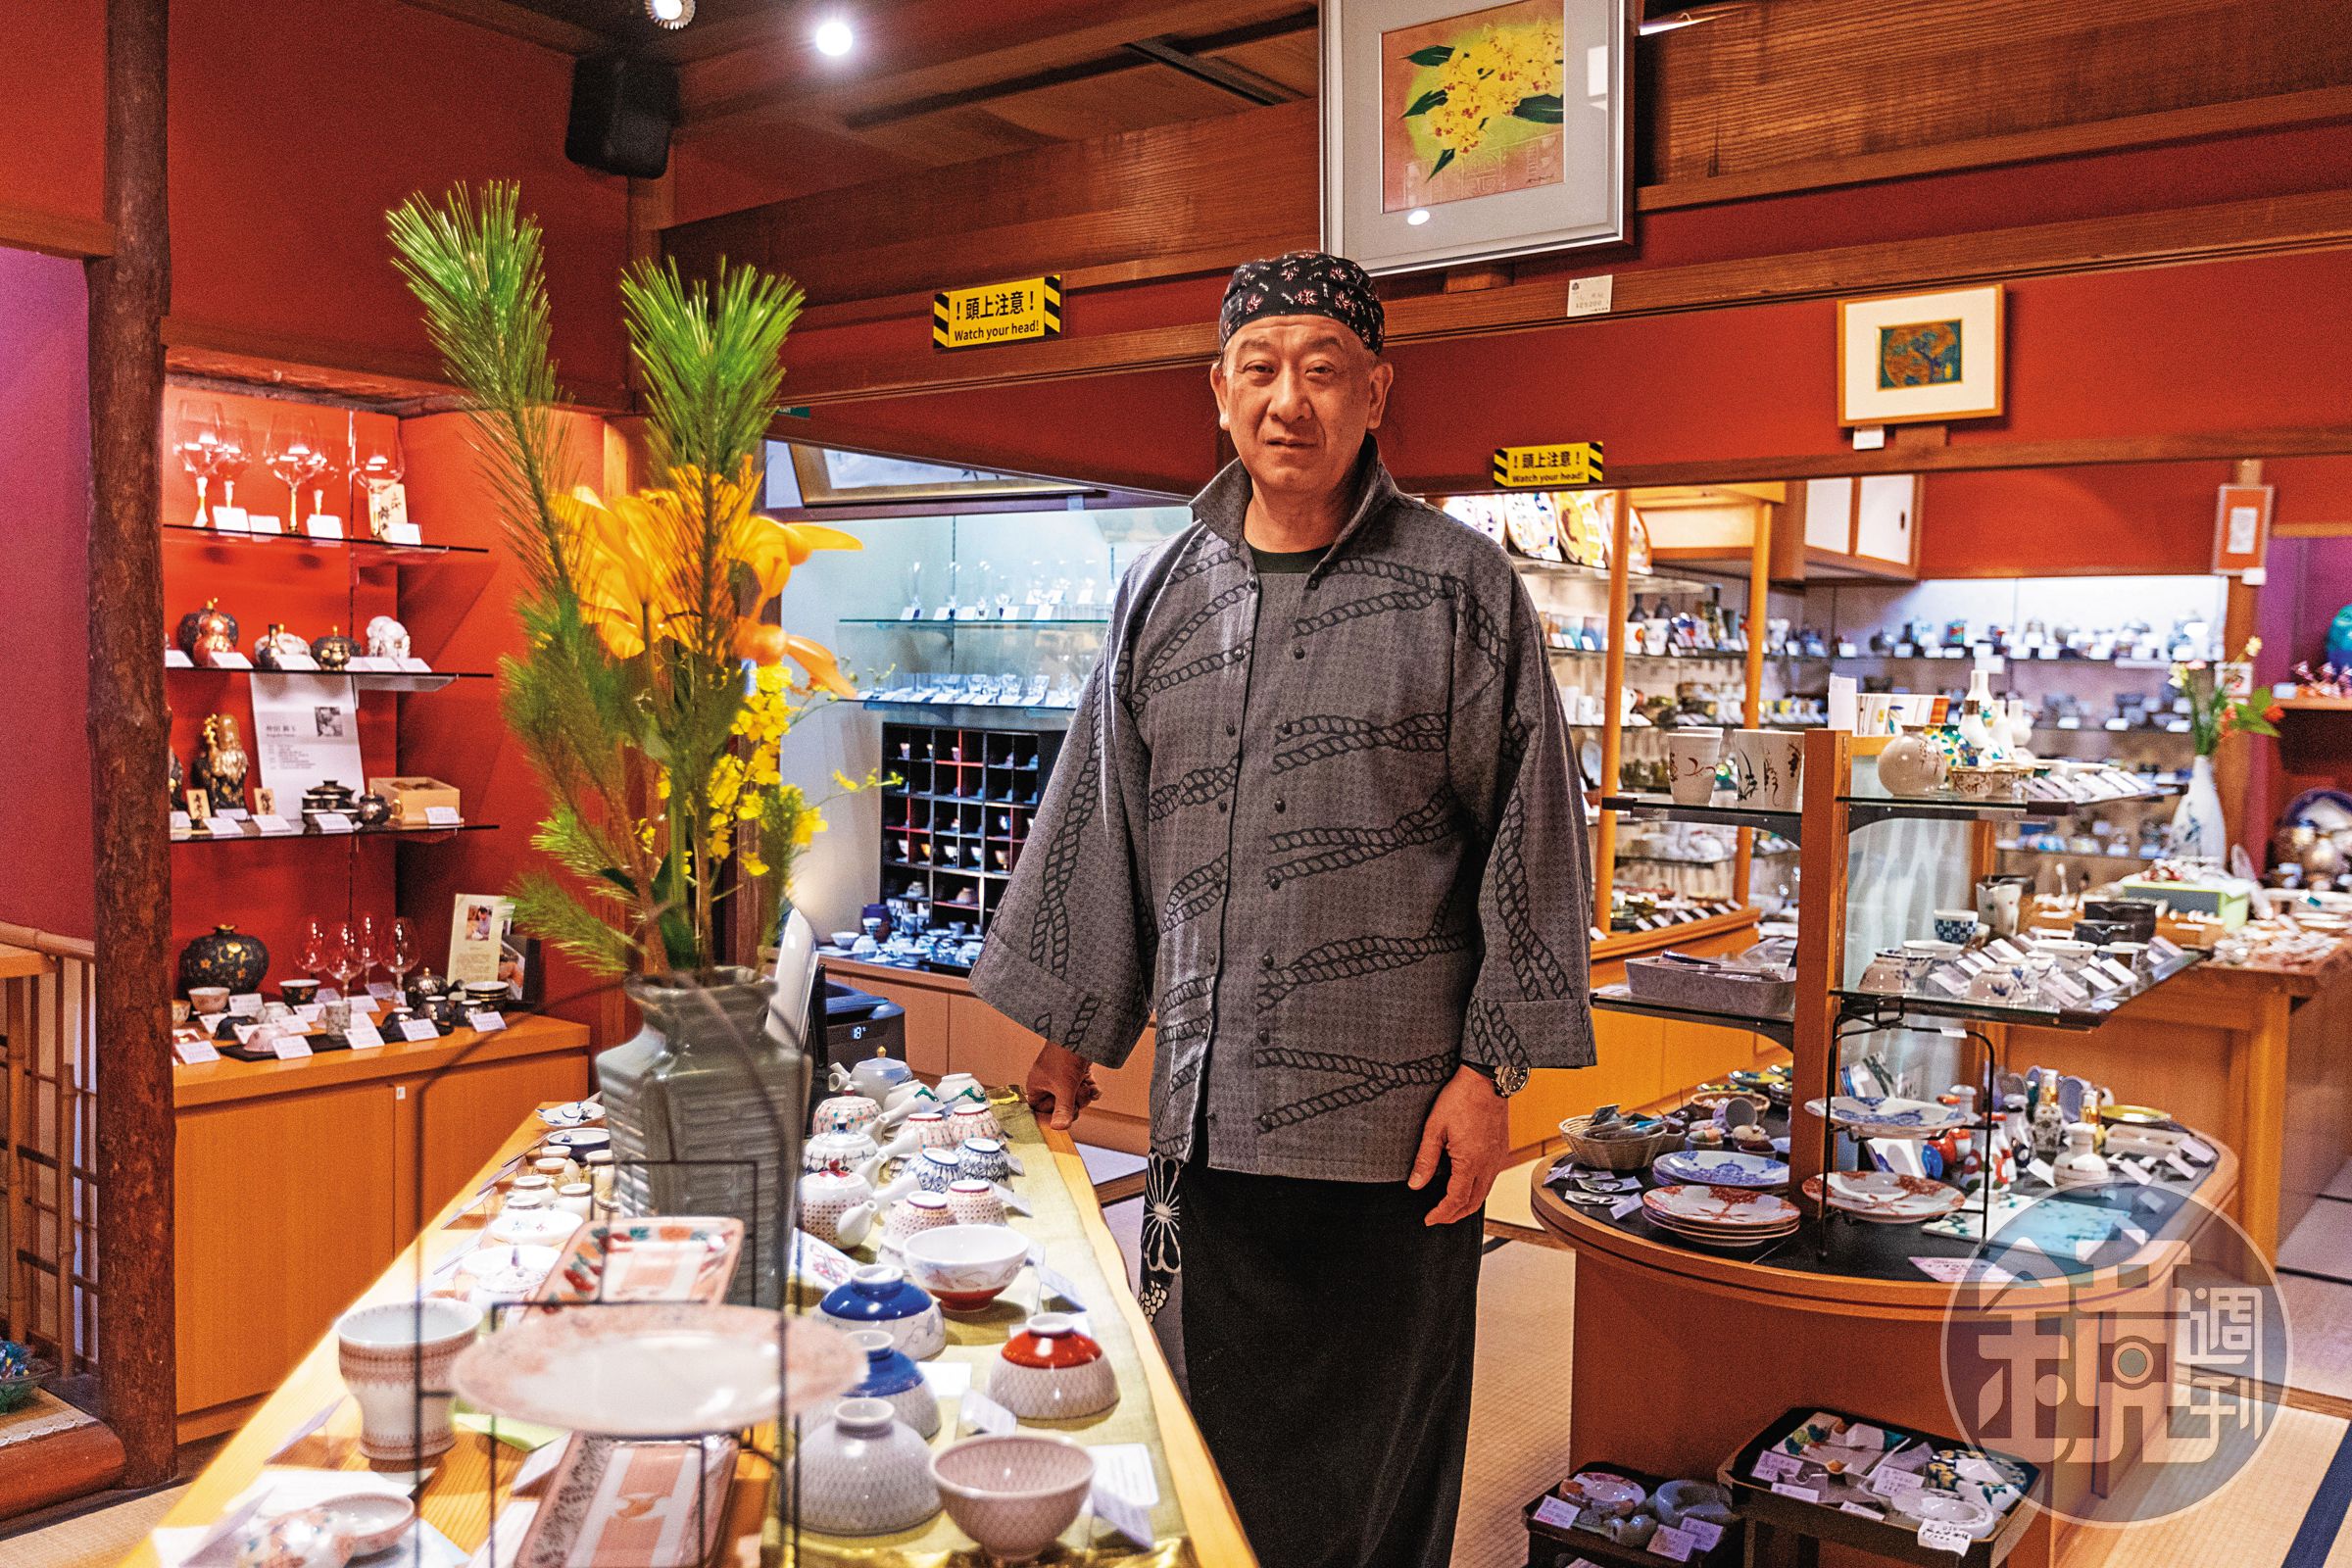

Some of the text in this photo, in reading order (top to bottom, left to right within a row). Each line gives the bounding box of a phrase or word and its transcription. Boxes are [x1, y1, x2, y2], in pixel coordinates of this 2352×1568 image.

[955, 319, 1039, 341] Watch your head!
[1512, 474, 1538, 483] Watch
[1540, 474, 1558, 483] your
